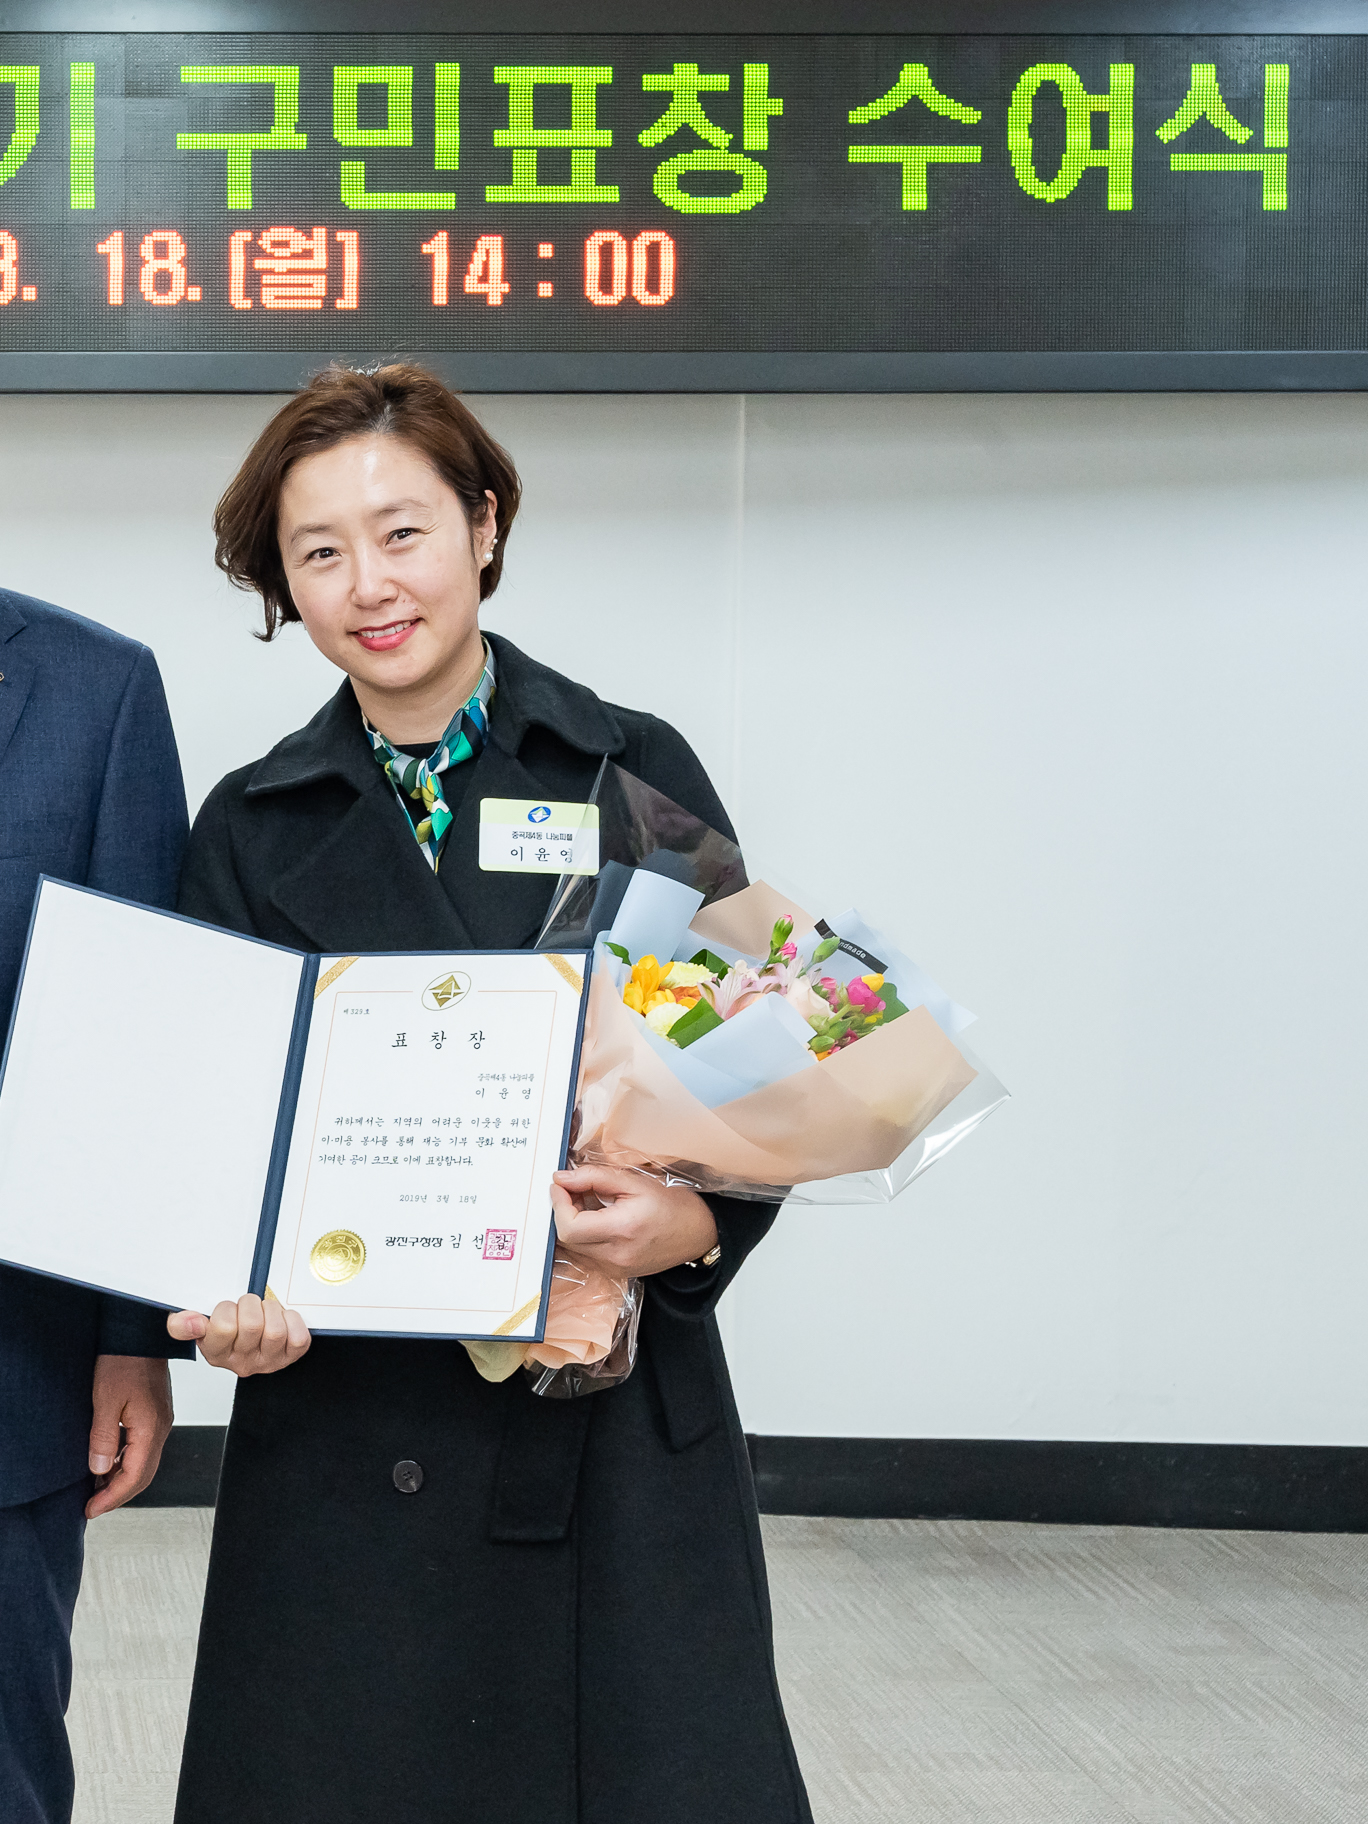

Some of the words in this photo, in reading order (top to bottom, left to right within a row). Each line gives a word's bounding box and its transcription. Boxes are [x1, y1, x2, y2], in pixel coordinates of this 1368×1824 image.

[176, 63, 783, 213] 구민표창
[848, 63, 1289, 213] 수여식
[512, 831, 543, 840] 중곡제4동
[393, 1116, 423, 1127] 지역의
[431, 1116, 462, 1129] 어려운
[471, 1117, 502, 1129] 이웃을
[510, 1117, 531, 1129] 위한
[360, 1135, 389, 1147] 봉사를
[395, 1135, 415, 1147] 통해
[422, 1136, 442, 1146] 재능
[449, 1136, 468, 1147] 기부
[475, 1136, 495, 1148] 문화
[500, 1136, 527, 1148] 확산에
[318, 1154, 346, 1166] 기여한
[349, 1154, 367, 1166] 공이
[371, 1155, 399, 1165] 크므로
[403, 1155, 421, 1165] 이에
[425, 1155, 474, 1166] 표창합니다.
[399, 1194, 427, 1204] 2019년
[436, 1194, 450, 1204] 3월
[459, 1194, 478, 1204] 18일
[385, 1235, 444, 1248] 광진구청장
